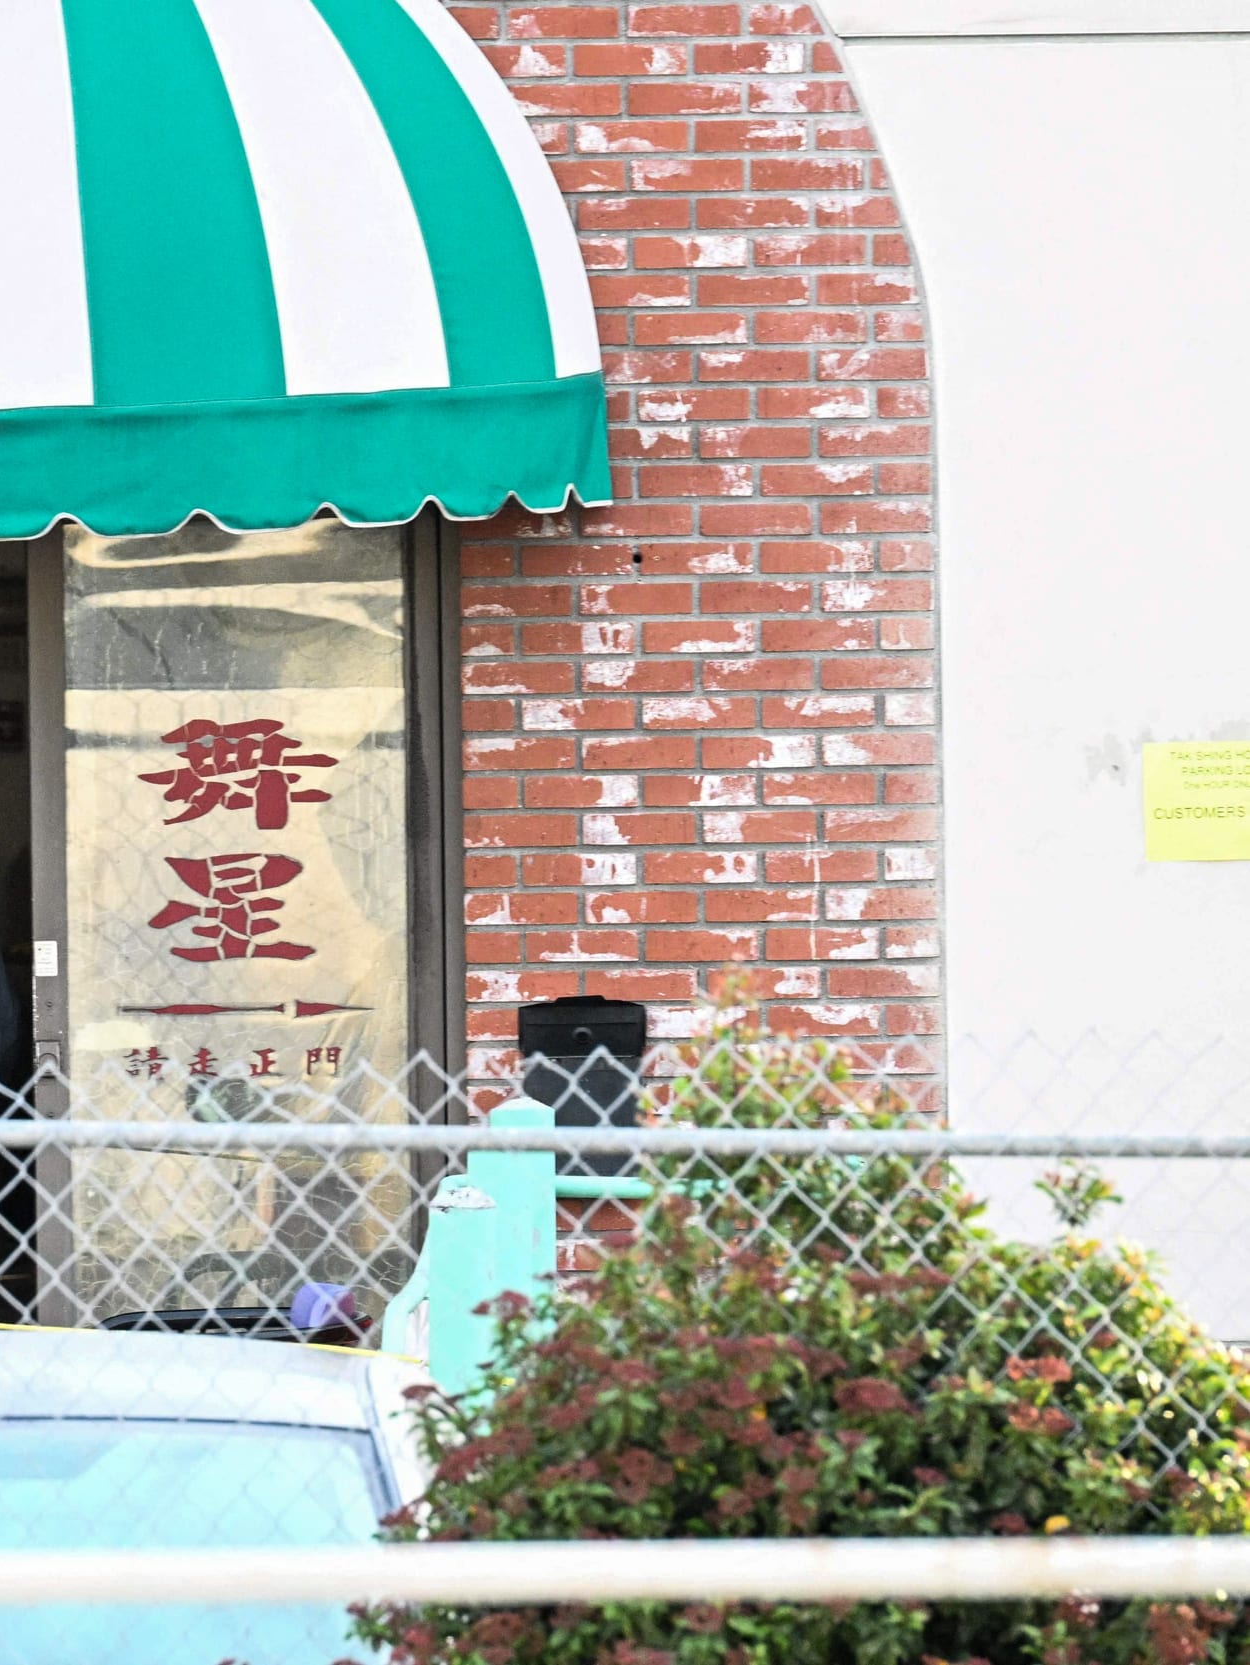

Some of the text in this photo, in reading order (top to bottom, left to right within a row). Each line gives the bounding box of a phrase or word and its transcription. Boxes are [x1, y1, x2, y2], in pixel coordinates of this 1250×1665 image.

[1182, 766, 1233, 776] PARKING
[1154, 806, 1246, 819] CUSTOMERS
[137, 719, 340, 962] 舞星
[123, 1046, 343, 1081] 請走正門
